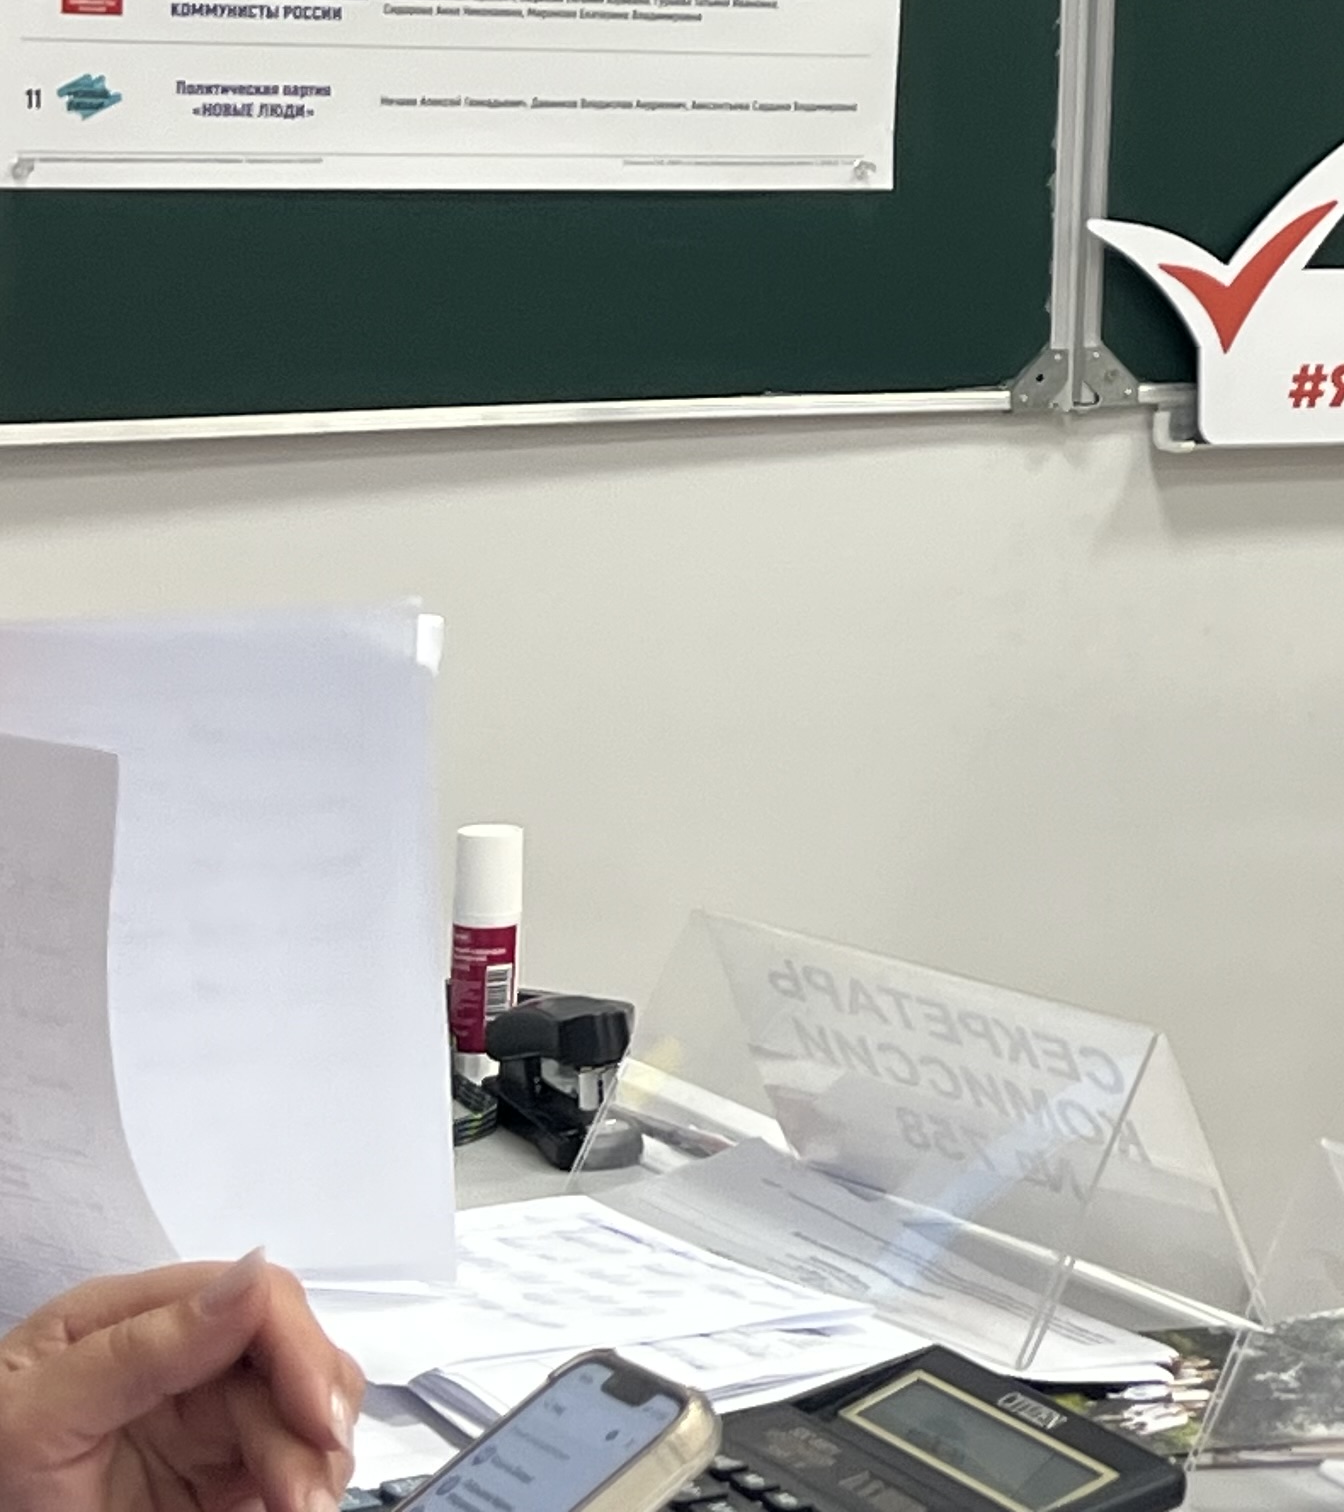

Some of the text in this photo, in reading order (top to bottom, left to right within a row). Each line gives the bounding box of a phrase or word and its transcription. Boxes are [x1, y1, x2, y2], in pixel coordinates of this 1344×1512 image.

[170, 4, 343, 21] КОММУНИСТЫ РОССИИ
[175, 80, 332, 99] Политическая партия
[26, 89, 42, 110] 11
[192, 102, 315, 120] «НОВЫЕ ЛЮДИ»
